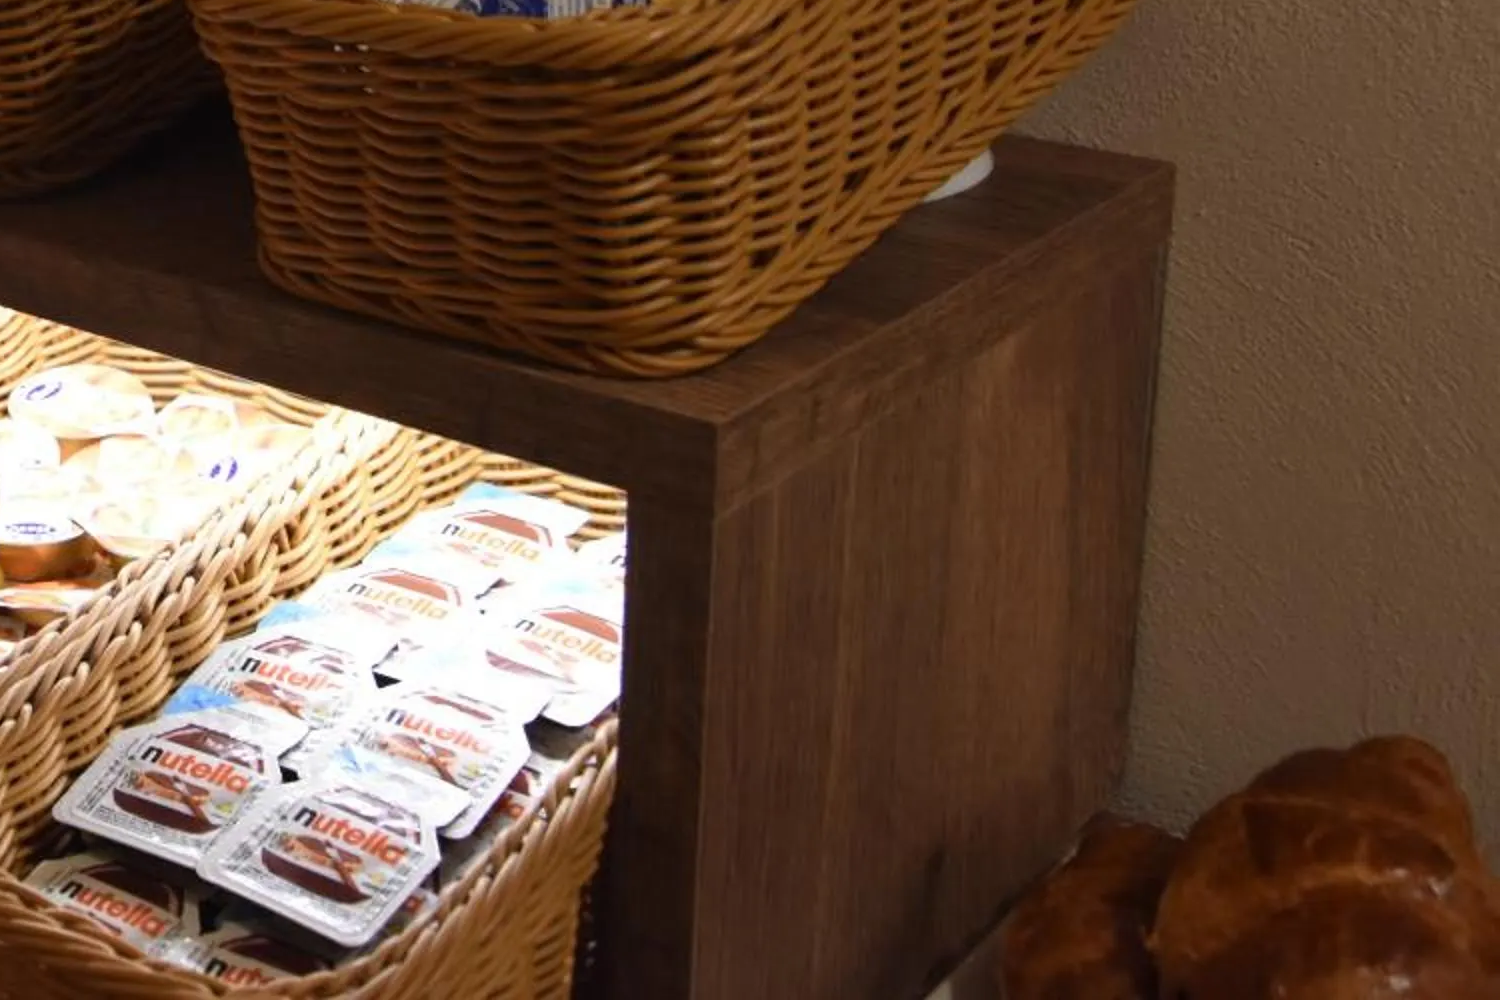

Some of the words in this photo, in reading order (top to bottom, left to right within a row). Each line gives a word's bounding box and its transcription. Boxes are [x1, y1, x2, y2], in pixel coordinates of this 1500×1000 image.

[441, 522, 540, 561] nutella
[347, 583, 448, 620] nutella
[516, 618, 616, 664] nutella
[142, 745, 249, 792] nutella
[295, 808, 405, 864] nutella
[61, 879, 165, 936] nutella
